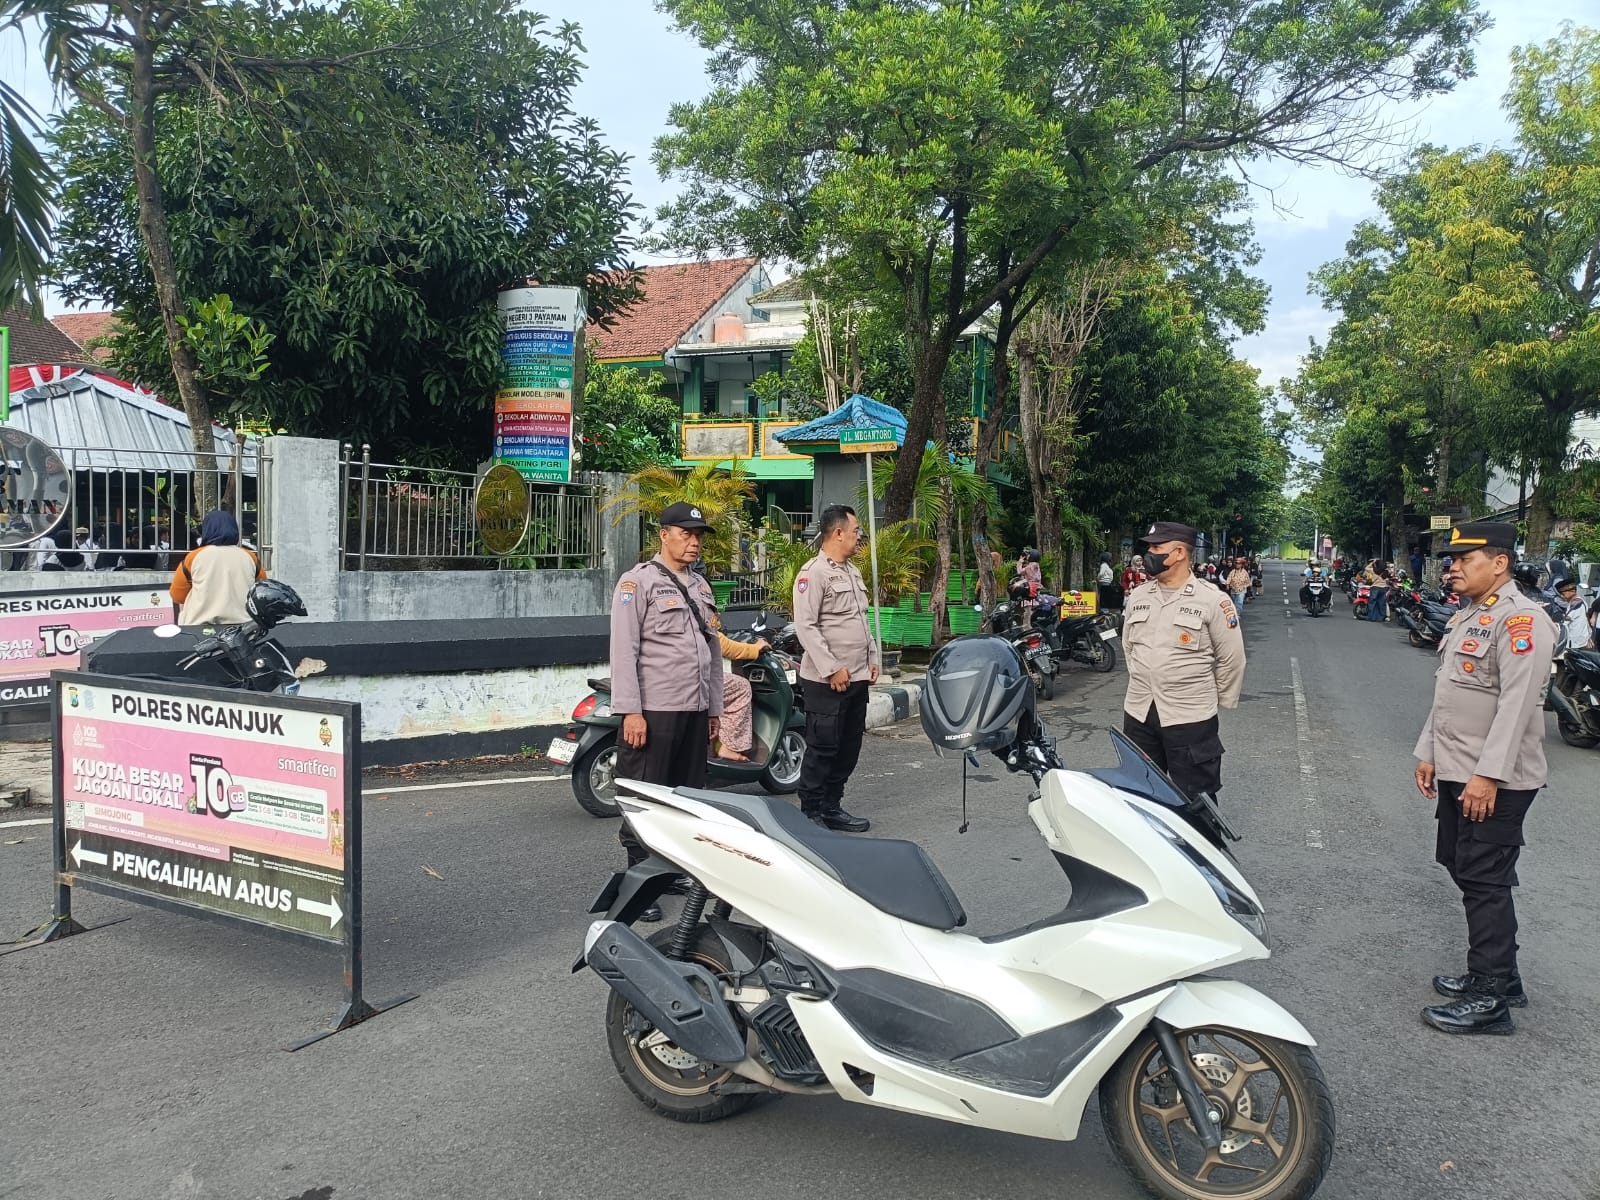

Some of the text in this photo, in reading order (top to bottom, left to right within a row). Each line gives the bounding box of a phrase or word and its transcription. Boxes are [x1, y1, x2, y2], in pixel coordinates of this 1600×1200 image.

[534, 313, 567, 322] PAYAMAN
[533, 332, 563, 341] SEKOLAH
[520, 390, 542, 398] MODEL
[504, 413, 566, 422] SEKOLAH ADIWIYATA
[524, 436, 546, 444] RAMAH
[854, 429, 892, 441] MEGANTORO
[524, 448, 564, 457] MEGANTARA
[531, 472, 563, 481] WANITA
[36, 595, 123, 611] NGANJUK
[1179, 606, 1203, 617] POLRI
[1465, 626, 1492, 639] POLRI
[40, 629, 81, 655] 10
[111, 694, 286, 738] POLRES NGANJUK
[944, 732, 973, 741] HONDA
[277, 756, 337, 778] smartfren
[72, 758, 185, 794] KUOTA BESAR
[73, 776, 184, 811] JAGOAN LOKAL
[190, 764, 233, 815] 10
[230, 791, 246, 804] GB
[94, 807, 133, 822] SIMOJONG
[112, 850, 232, 899] PENGALIHAN
[234, 878, 293, 912] ARUS
